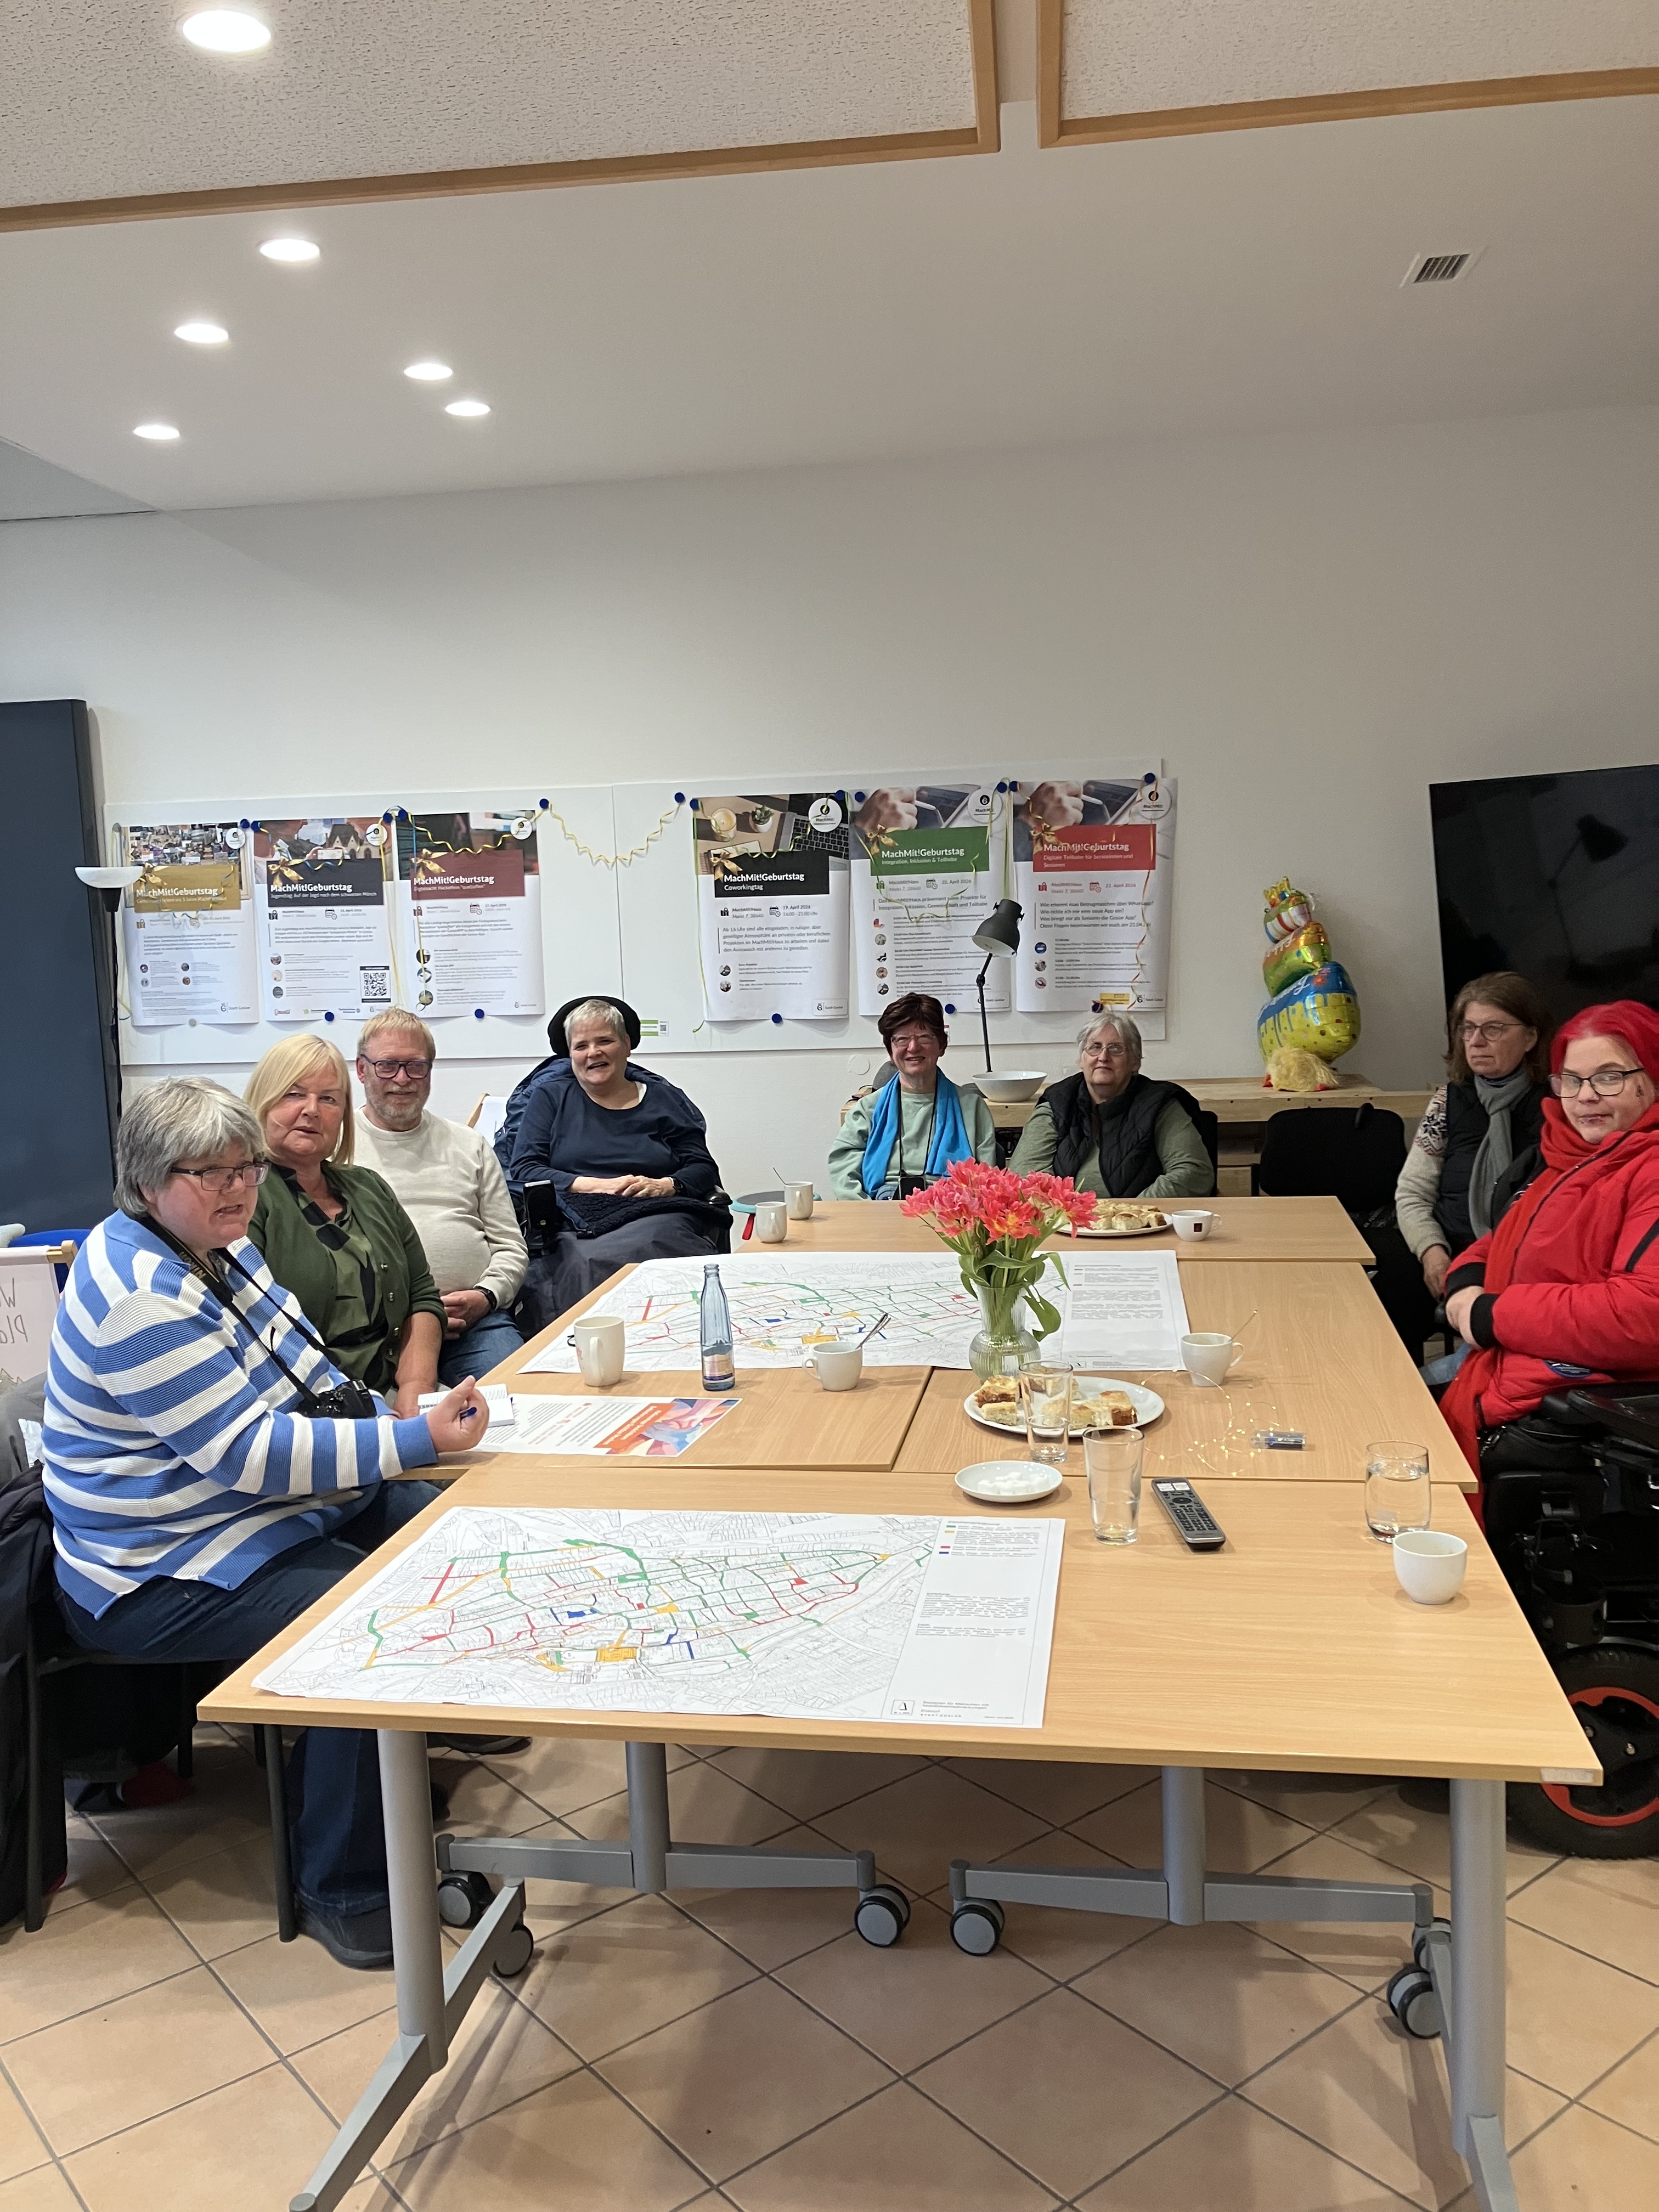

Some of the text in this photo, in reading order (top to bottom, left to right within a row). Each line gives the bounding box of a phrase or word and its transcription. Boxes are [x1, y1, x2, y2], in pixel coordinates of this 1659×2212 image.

[882, 848, 964, 858] MachMit!Geburtstag
[414, 876, 494, 885] MachMit!Geburtstag
[724, 873, 805, 883] MachMit!Geburtstag
[270, 883, 352, 893] MachMit!Geburtstag
